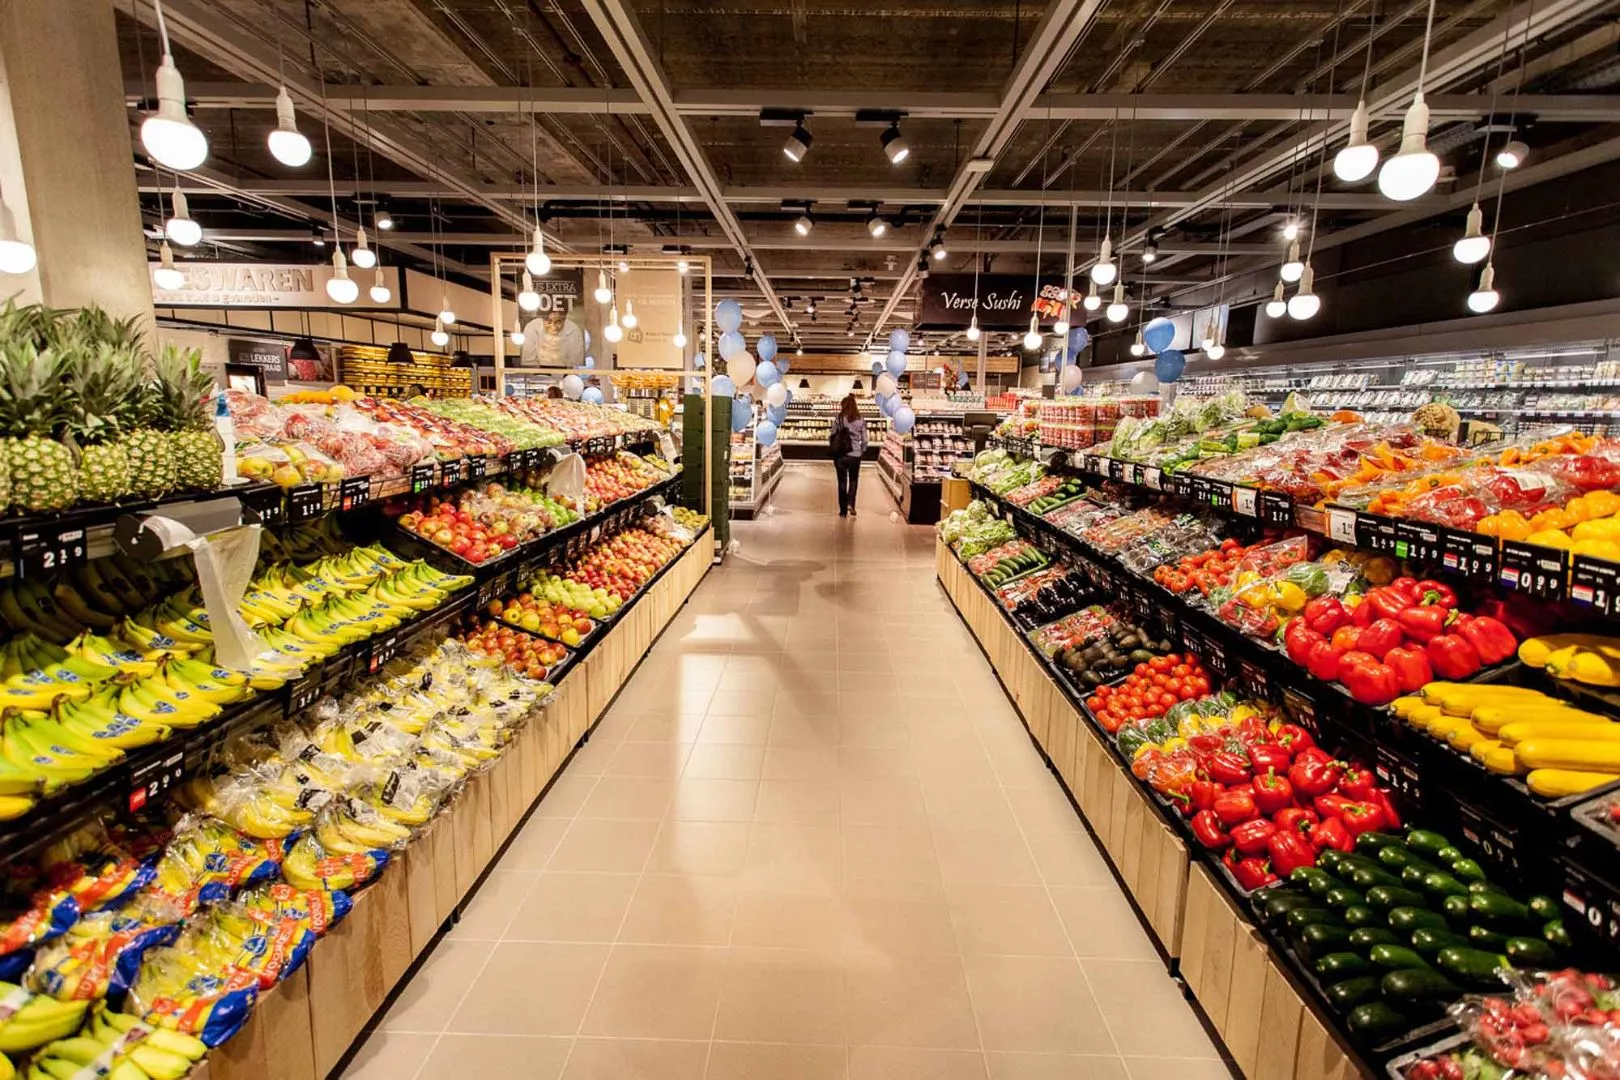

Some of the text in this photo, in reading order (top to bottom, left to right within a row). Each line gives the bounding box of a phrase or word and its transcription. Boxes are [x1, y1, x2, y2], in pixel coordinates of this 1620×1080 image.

[177, 267, 315, 293] ESWAREN
[539, 293, 577, 312] OET
[941, 289, 1023, 310] Verse Sushi
